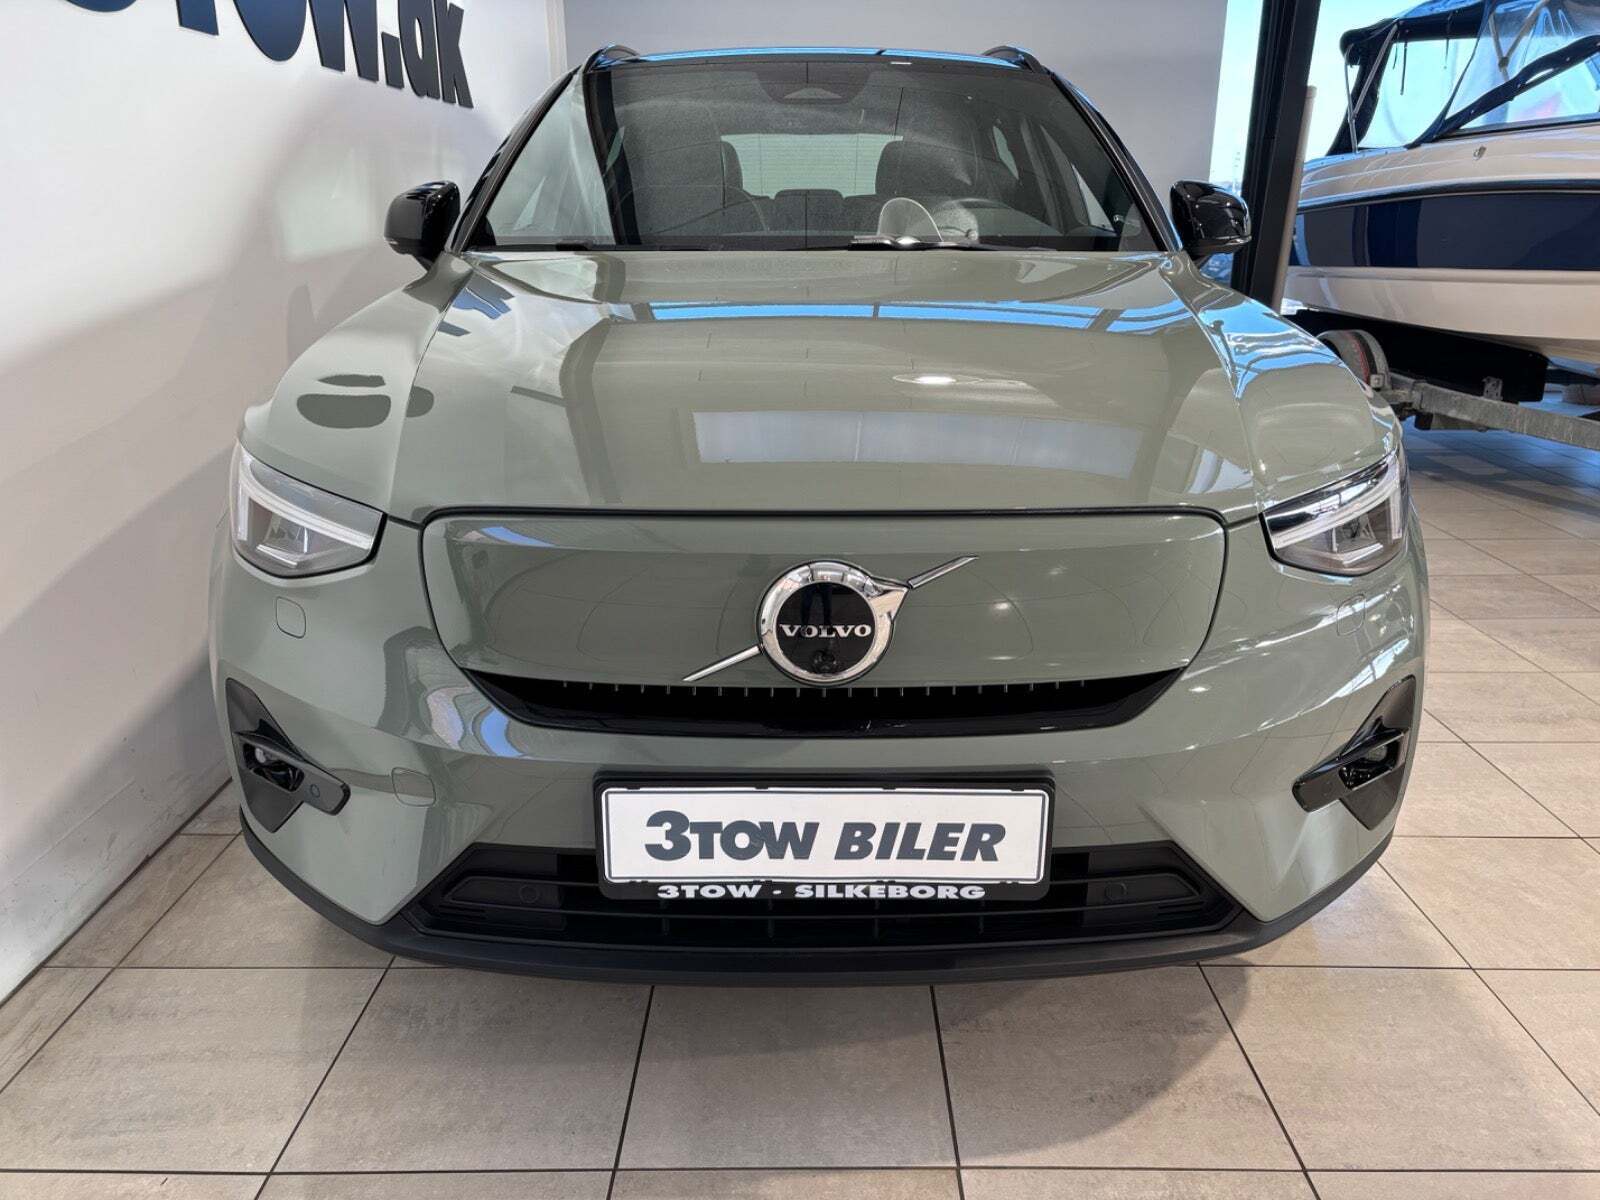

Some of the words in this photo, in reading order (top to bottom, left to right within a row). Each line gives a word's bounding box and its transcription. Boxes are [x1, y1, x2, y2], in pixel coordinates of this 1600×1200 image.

[779, 623, 872, 638] VOLVO
[644, 810, 820, 862] 3TOW
[834, 822, 1006, 862] BILER
[657, 884, 763, 899] 3TOW
[794, 884, 986, 900] SILKEBORG
